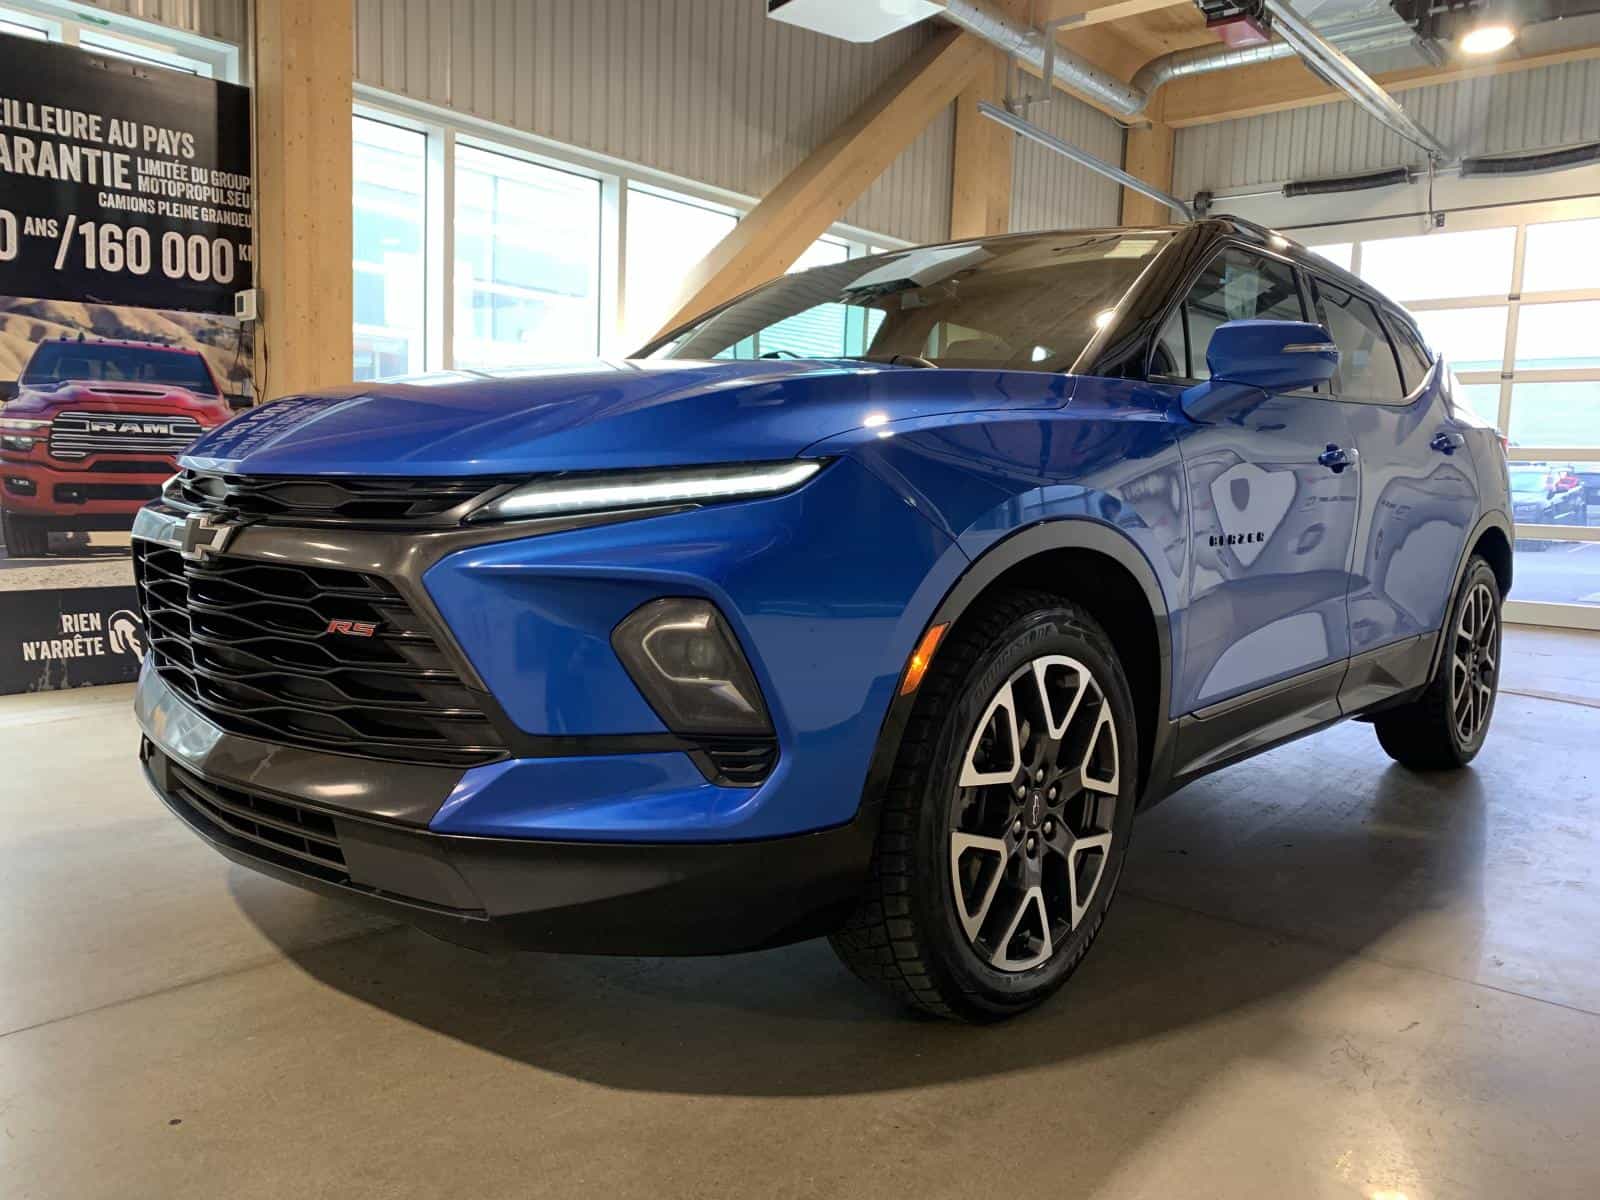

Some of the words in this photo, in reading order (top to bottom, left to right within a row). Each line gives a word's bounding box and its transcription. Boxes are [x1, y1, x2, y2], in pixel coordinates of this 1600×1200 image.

[0, 96, 103, 143] ILLEURE
[108, 118, 137, 149] AU
[143, 124, 195, 159] PAYS
[137, 157, 190, 182] LIMITÉE
[191, 166, 208, 185] DU
[98, 192, 156, 214] CAMIONS
[158, 200, 200, 221] PLEINE
[23, 215, 59, 239] ANS
[162, 231, 234, 284] 000
[91, 421, 169, 434] RAM
[61, 612, 102, 633] RIEN
[327, 619, 376, 638] RS
[22, 633, 105, 661] N'ARRÊTE
